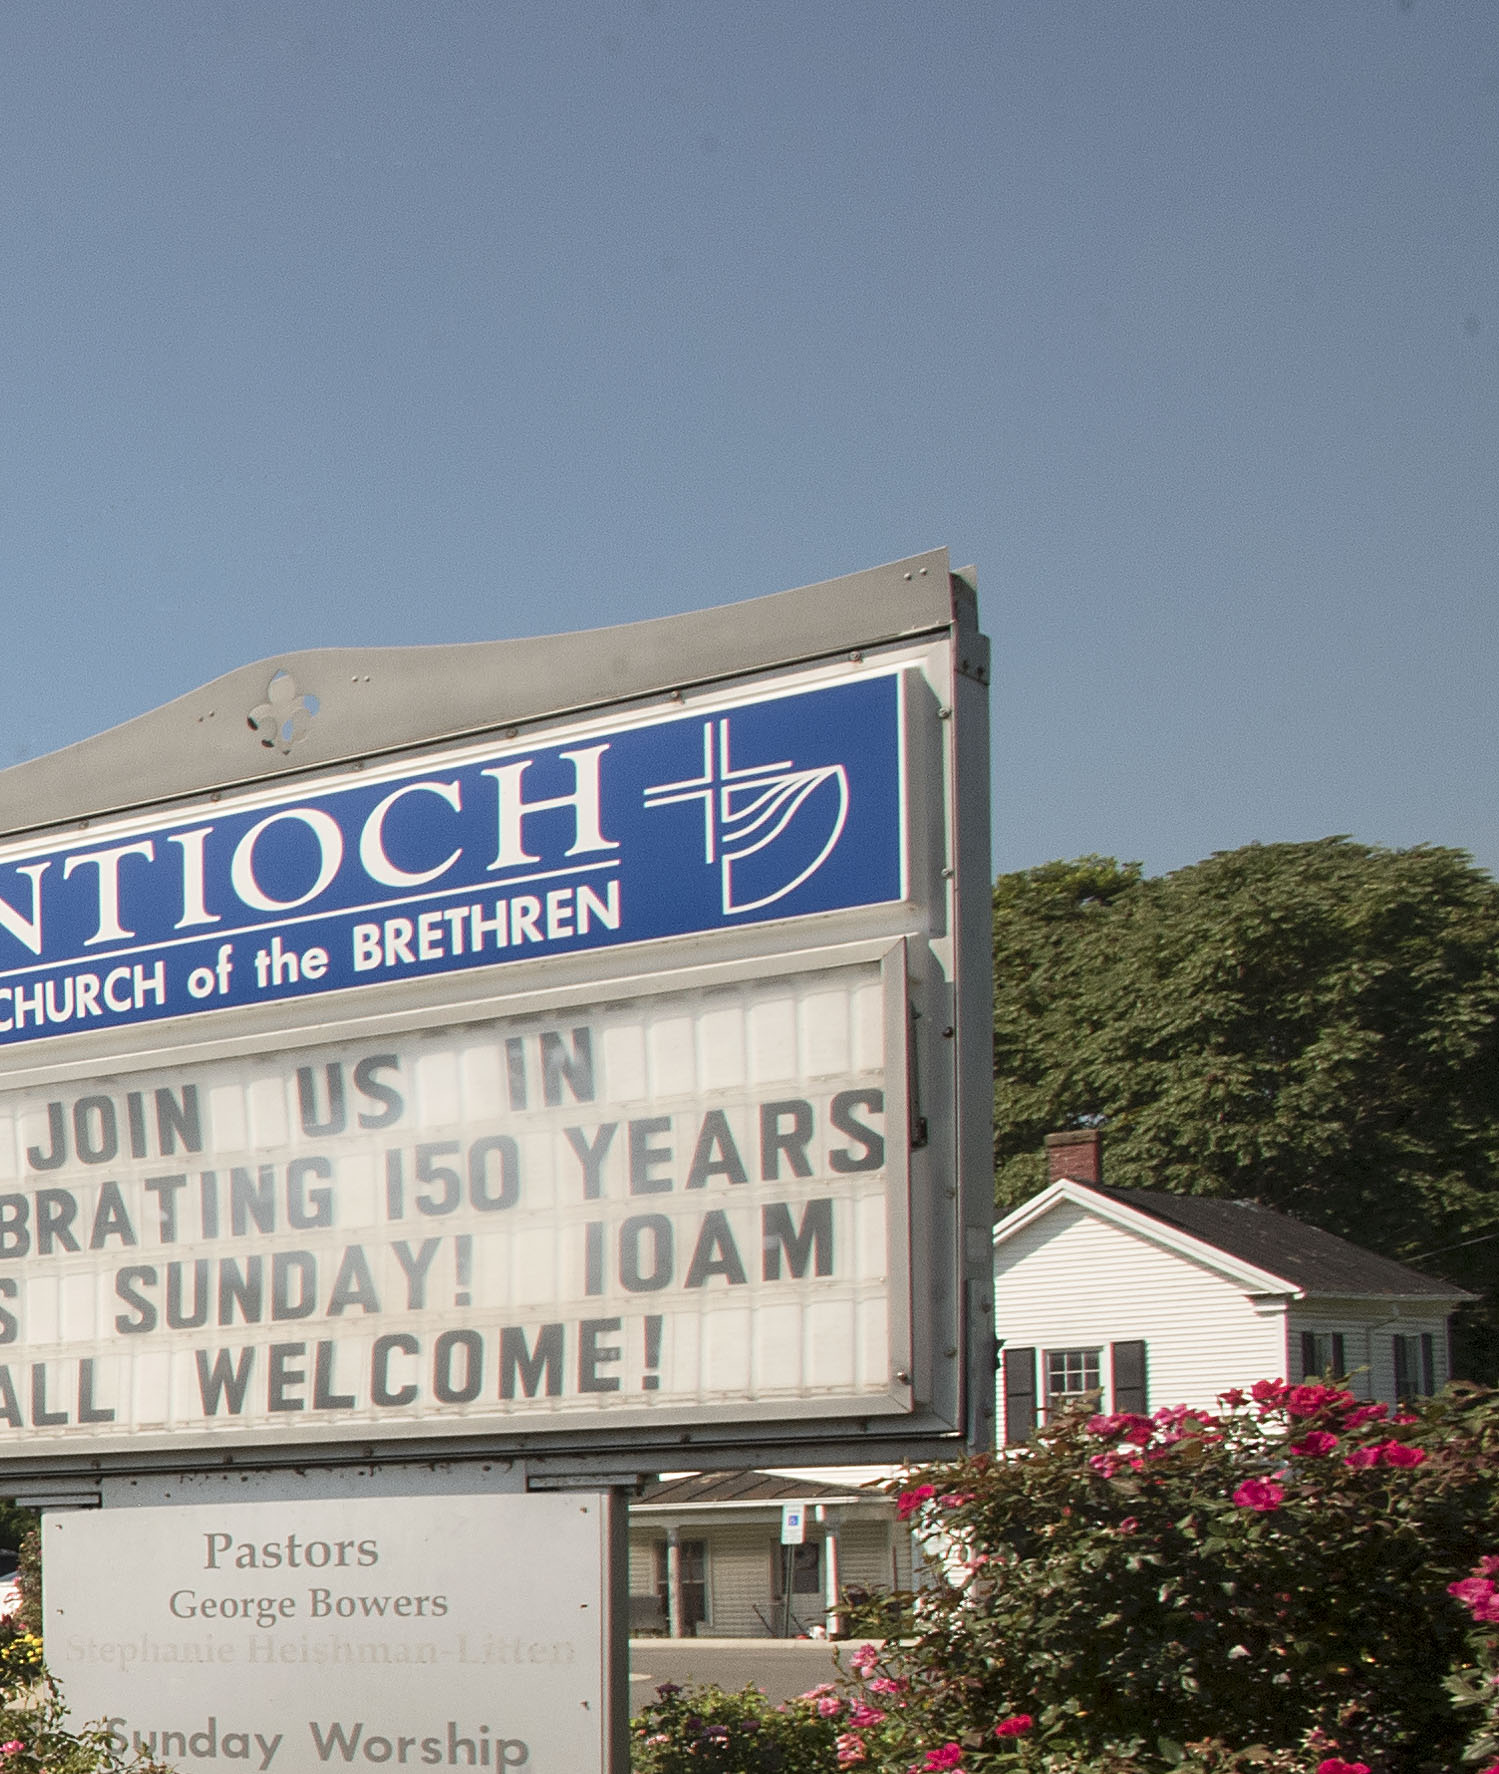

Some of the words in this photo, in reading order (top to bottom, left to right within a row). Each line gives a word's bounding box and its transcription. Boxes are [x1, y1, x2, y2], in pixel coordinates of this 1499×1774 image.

[188, 944, 234, 998] of
[255, 936, 329, 986] the
[353, 881, 620, 971] BRETHREN
[26, 1085, 203, 1171] JOIN
[297, 1054, 403, 1138] US
[506, 1028, 594, 1111] IN
[386, 1136, 521, 1221] 150
[562, 1088, 886, 1199] YEARS
[115, 1234, 474, 1335] SUNDAY!
[584, 1199, 835, 1297] 10AM
[195, 1315, 664, 1416] WELCOME!
[203, 1532, 380, 1569] Pastors
[169, 1590, 297, 1627] George
[309, 1588, 449, 1618] Bowers
[104, 1716, 283, 1771] Sunday
